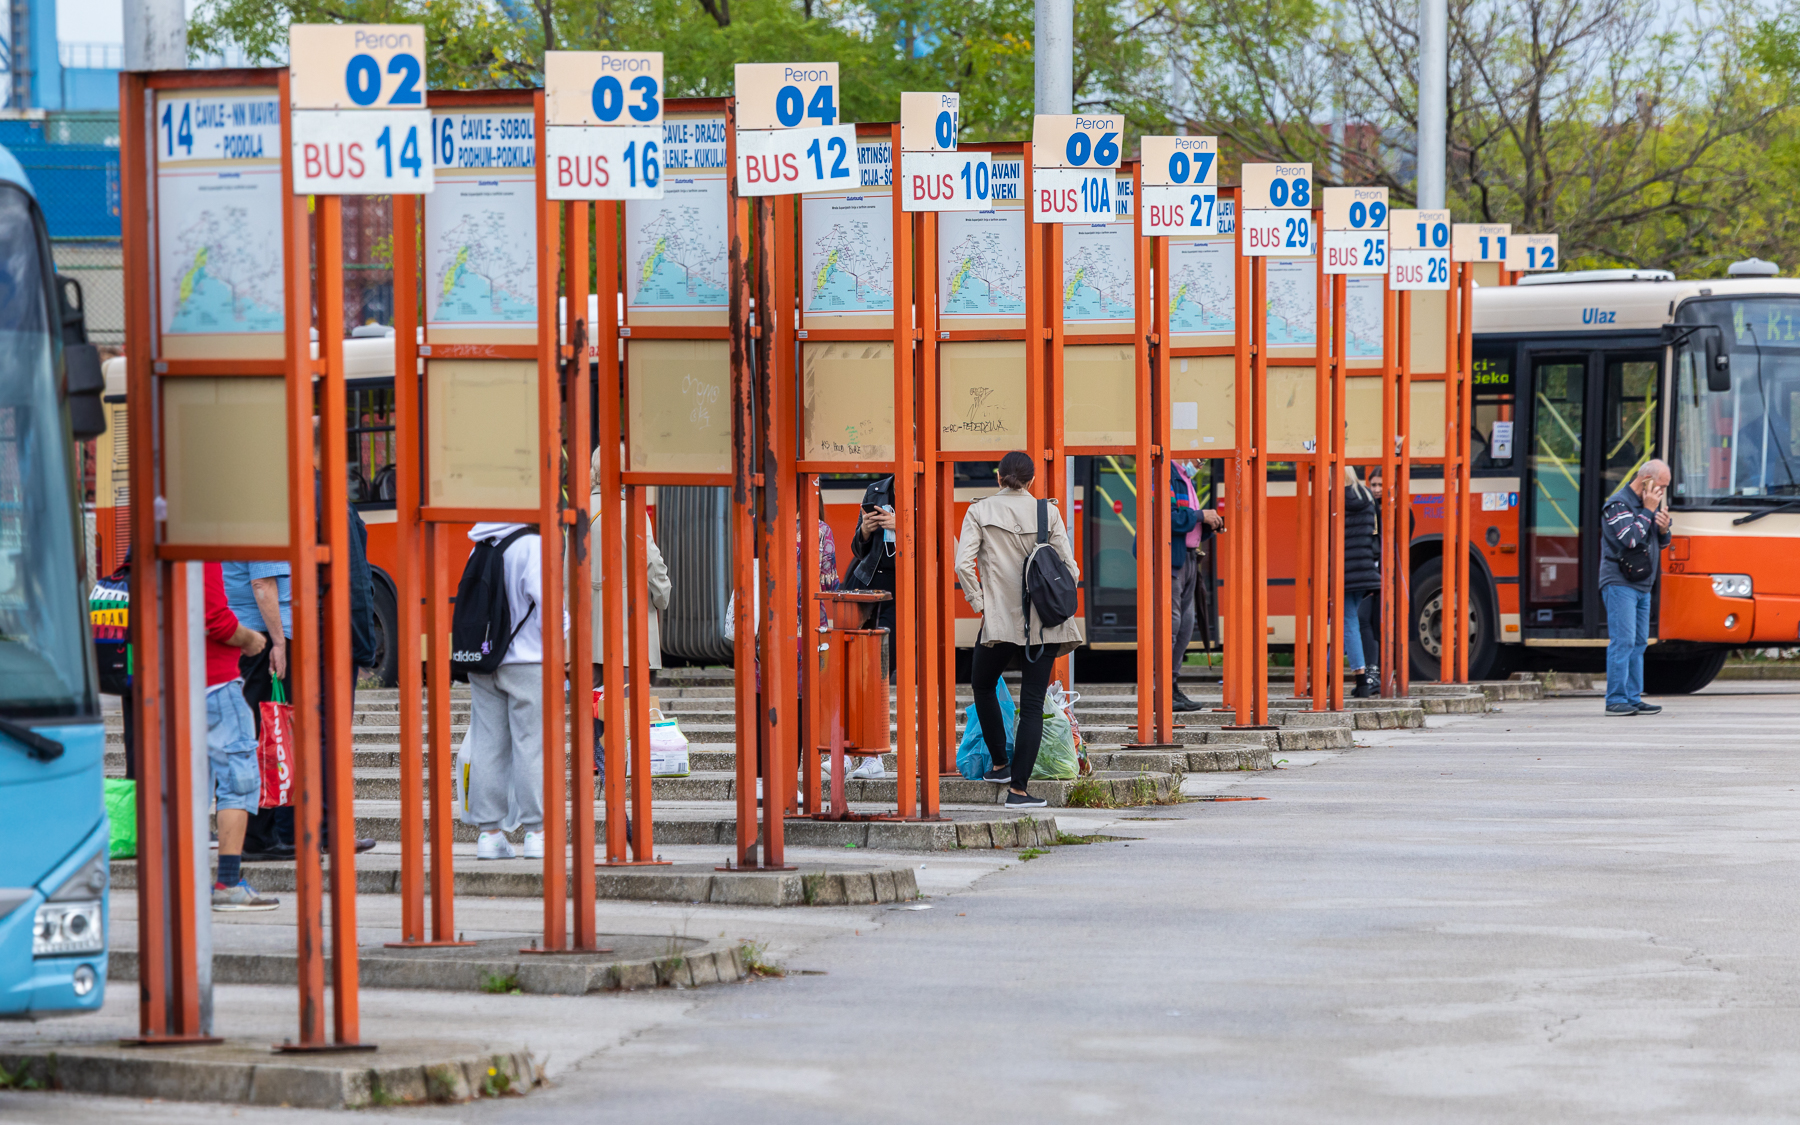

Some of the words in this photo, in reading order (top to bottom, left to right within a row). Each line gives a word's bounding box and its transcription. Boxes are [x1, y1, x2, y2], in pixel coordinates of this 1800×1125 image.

[355, 30, 412, 49] Peron
[602, 55, 650, 71] Peron
[785, 68, 827, 81] Peron
[346, 54, 421, 106] 02
[592, 76, 659, 122] 03
[776, 85, 836, 124] 04
[162, 103, 194, 157] 14
[1076, 118, 1113, 129] Peron
[432, 117, 454, 165] 16
[461, 115, 491, 140] ČAVLE
[1066, 132, 1119, 166] 06
[1176, 138, 1208, 149] Peron
[304, 143, 365, 179] BUS
[377, 126, 421, 178] 14
[458, 146, 491, 168] PODHUM
[663, 149, 688, 168] LENJE
[746, 153, 798, 183] BUS
[807, 137, 850, 179] 12
[558, 156, 609, 187] BUS
[624, 141, 659, 188] 16
[991, 162, 1020, 179] AVANI
[1169, 152, 1215, 184] 07
[1276, 165, 1305, 176] Peron
[913, 174, 953, 200] BUS
[961, 162, 988, 199] 10
[991, 183, 1017, 199] AVEKI
[1270, 178, 1310, 207] 08
[1041, 189, 1077, 212] BUS
[1082, 178, 1110, 213] 10A
[1355, 190, 1382, 199] Peron
[1151, 205, 1183, 226] BUS
[1190, 195, 1215, 226] 27
[1349, 202, 1386, 228] 09
[1419, 211, 1445, 221] Peron
[1250, 228, 1280, 247] BUS
[1286, 218, 1308, 247] 29
[1417, 223, 1448, 247] 10
[1480, 225, 1505, 234] Peron
[1330, 248, 1357, 266] BUS
[1364, 239, 1384, 266] 25
[1479, 236, 1507, 259] 11
[1527, 246, 1555, 268] 12
[1397, 265, 1423, 282] BUS
[1428, 258, 1447, 282] 26
[1582, 308, 1616, 324] Ulaz
[1733, 303, 1745, 340] 4
[1767, 305, 1800, 340] Ki
[1473, 358, 1496, 371] ci-
[1471, 372, 1509, 384] jeka
[1669, 563, 1685, 573] 670
[91, 611, 123, 626] RDAN
[453, 650, 482, 661] didas
